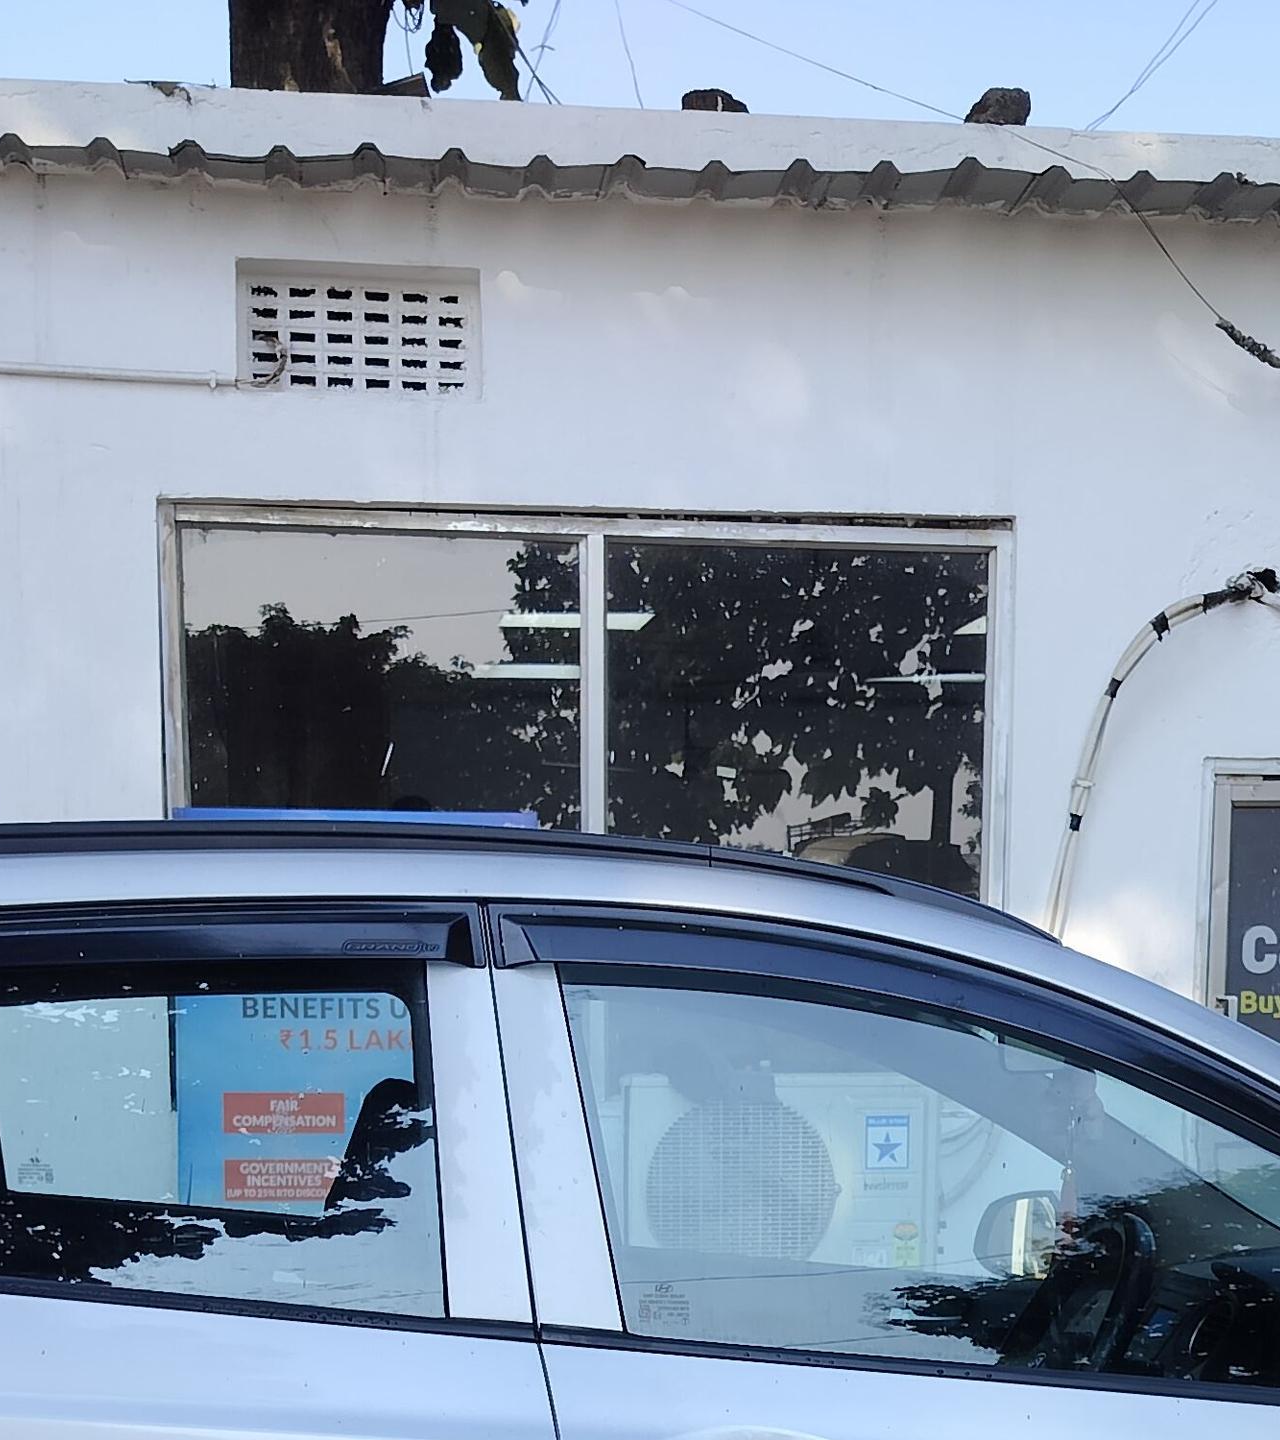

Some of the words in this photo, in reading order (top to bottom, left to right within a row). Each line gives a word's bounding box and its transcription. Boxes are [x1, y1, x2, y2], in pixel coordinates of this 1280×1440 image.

[241, 996, 380, 1019] BENEFITS
[269, 1099, 299, 1112] FAIR
[239, 1161, 328, 1175] GOVERNMENT
[246, 1174, 322, 1187] INCENTIVES
